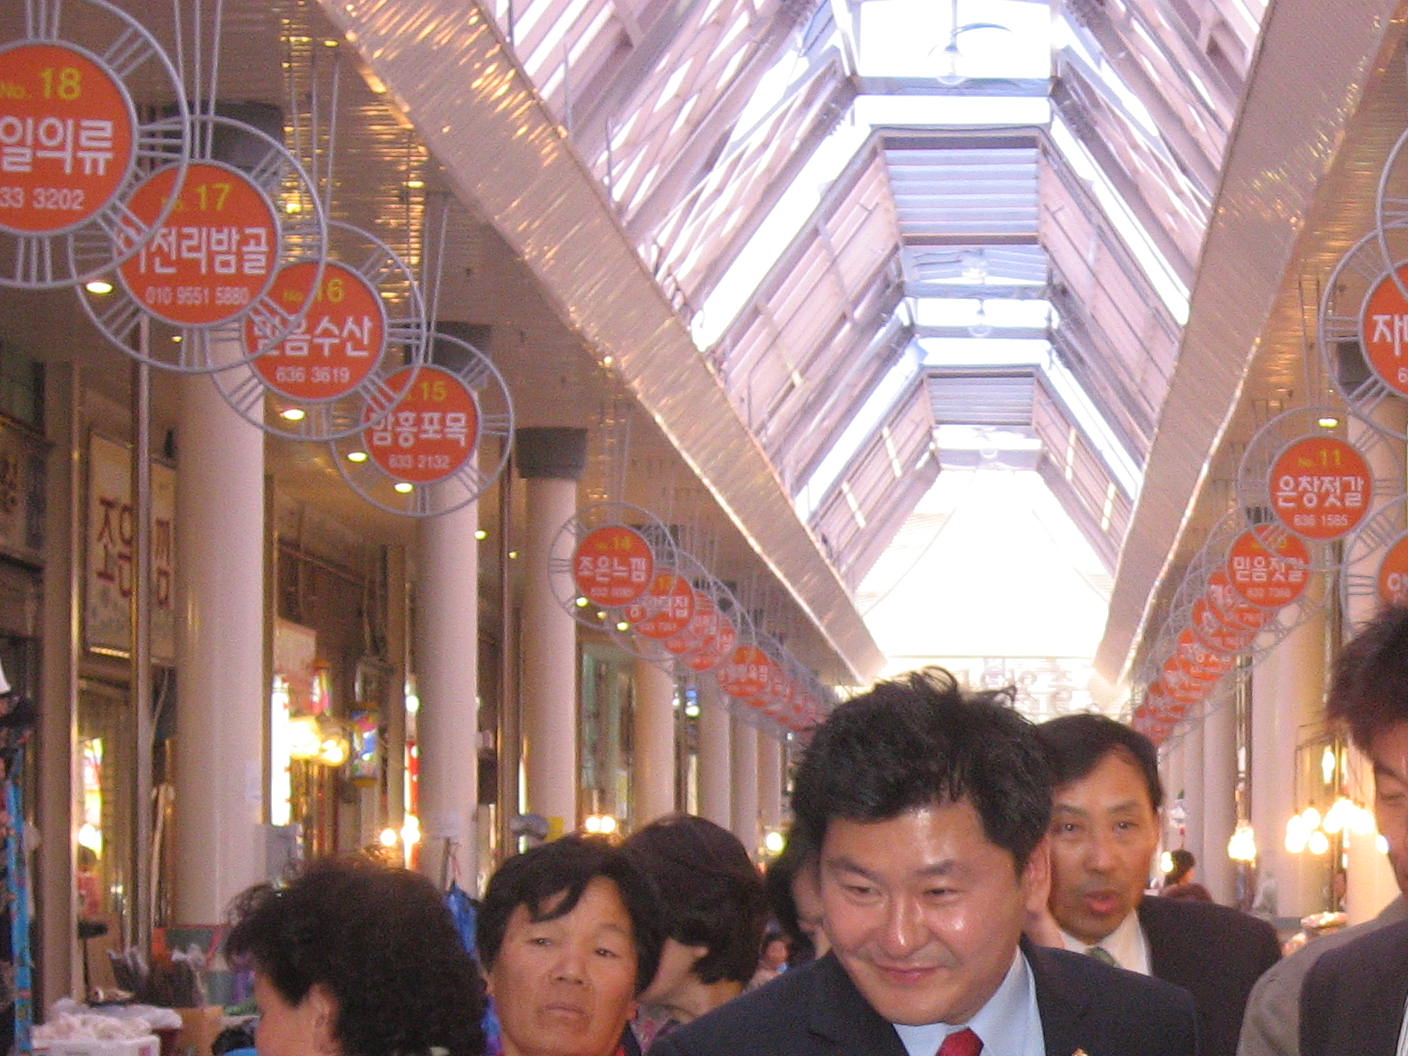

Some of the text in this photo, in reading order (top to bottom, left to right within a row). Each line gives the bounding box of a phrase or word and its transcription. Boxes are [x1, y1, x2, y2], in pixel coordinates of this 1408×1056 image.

[40, 67, 82, 99] 18
[33, 187, 85, 210] 3202
[196, 183, 231, 211] 17
[420, 380, 448, 402] 15
